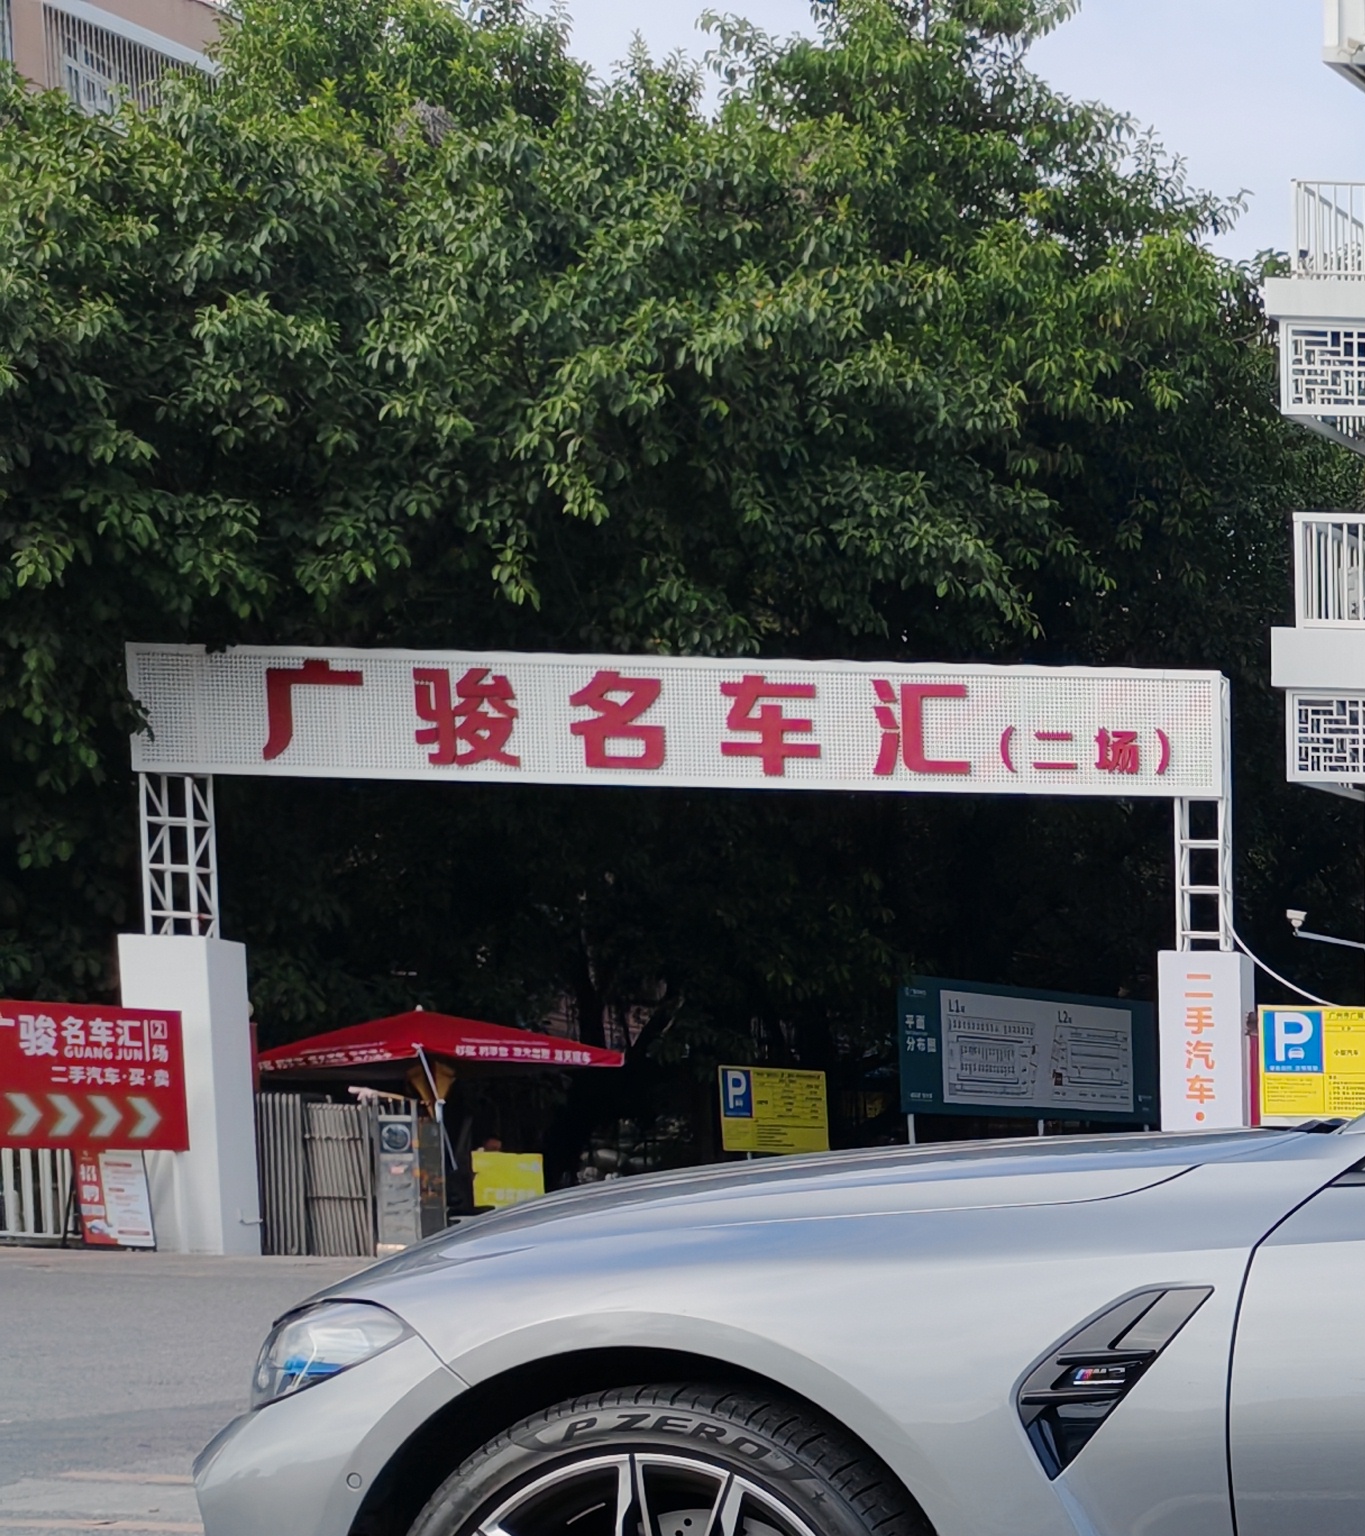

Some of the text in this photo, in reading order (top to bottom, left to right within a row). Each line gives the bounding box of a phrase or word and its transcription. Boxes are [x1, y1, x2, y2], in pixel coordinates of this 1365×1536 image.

[63, 1045, 143, 1061] GUANG JUN
[563, 1413, 772, 1460] P ZERO
